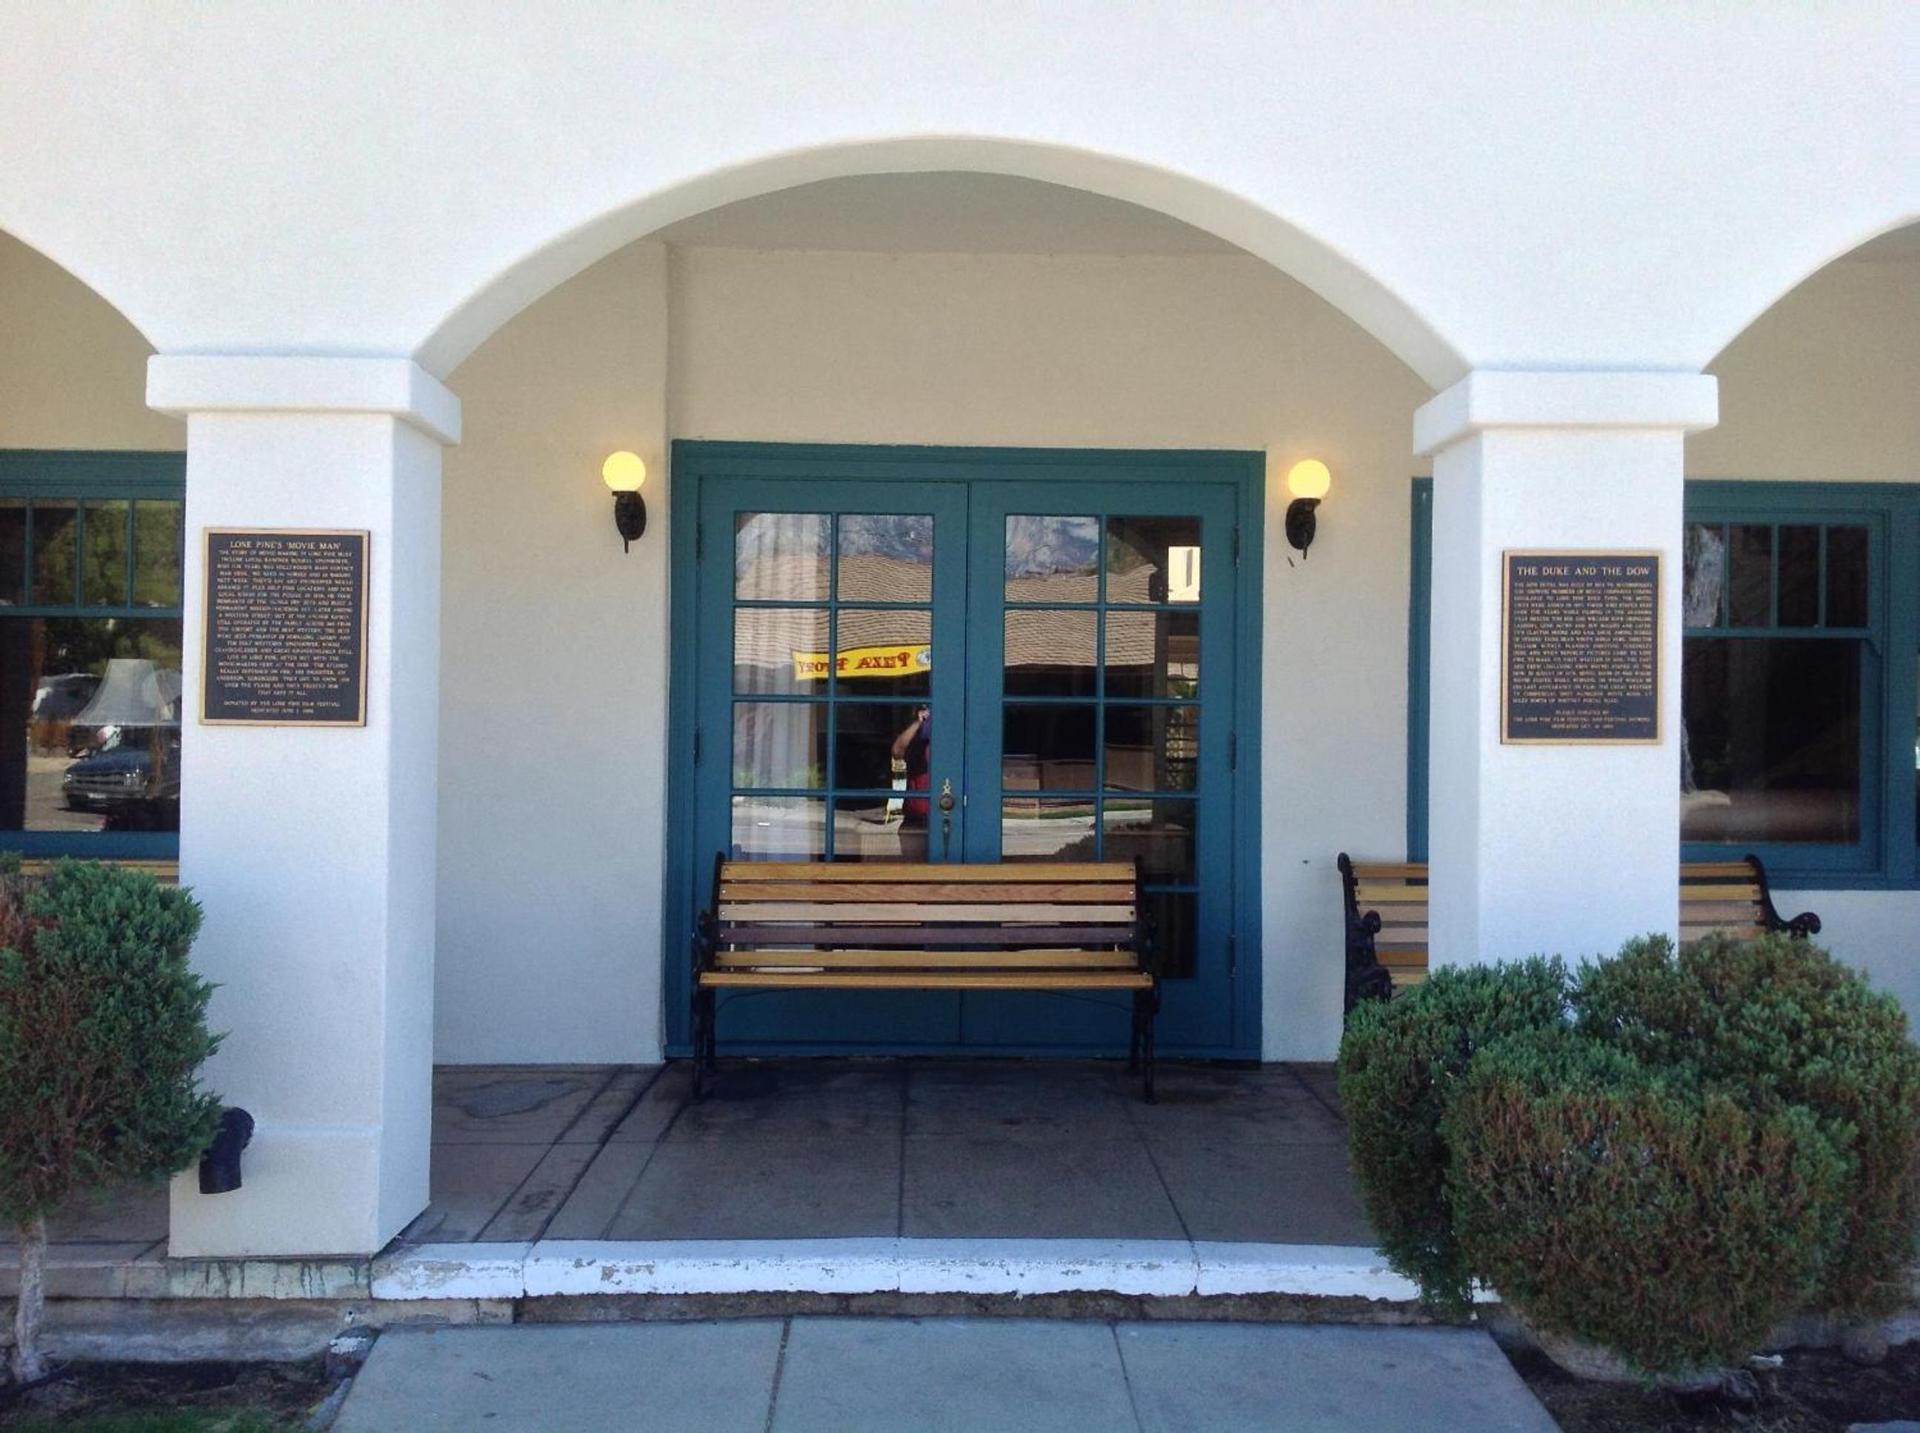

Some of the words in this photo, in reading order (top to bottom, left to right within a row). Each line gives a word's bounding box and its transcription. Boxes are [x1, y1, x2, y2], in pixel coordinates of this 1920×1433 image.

[1517, 567, 1537, 575] THE
[1542, 567, 1568, 575] DUKE
[1575, 567, 1596, 575] AND
[1602, 567, 1622, 575] THE
[1627, 567, 1650, 575] DOW
